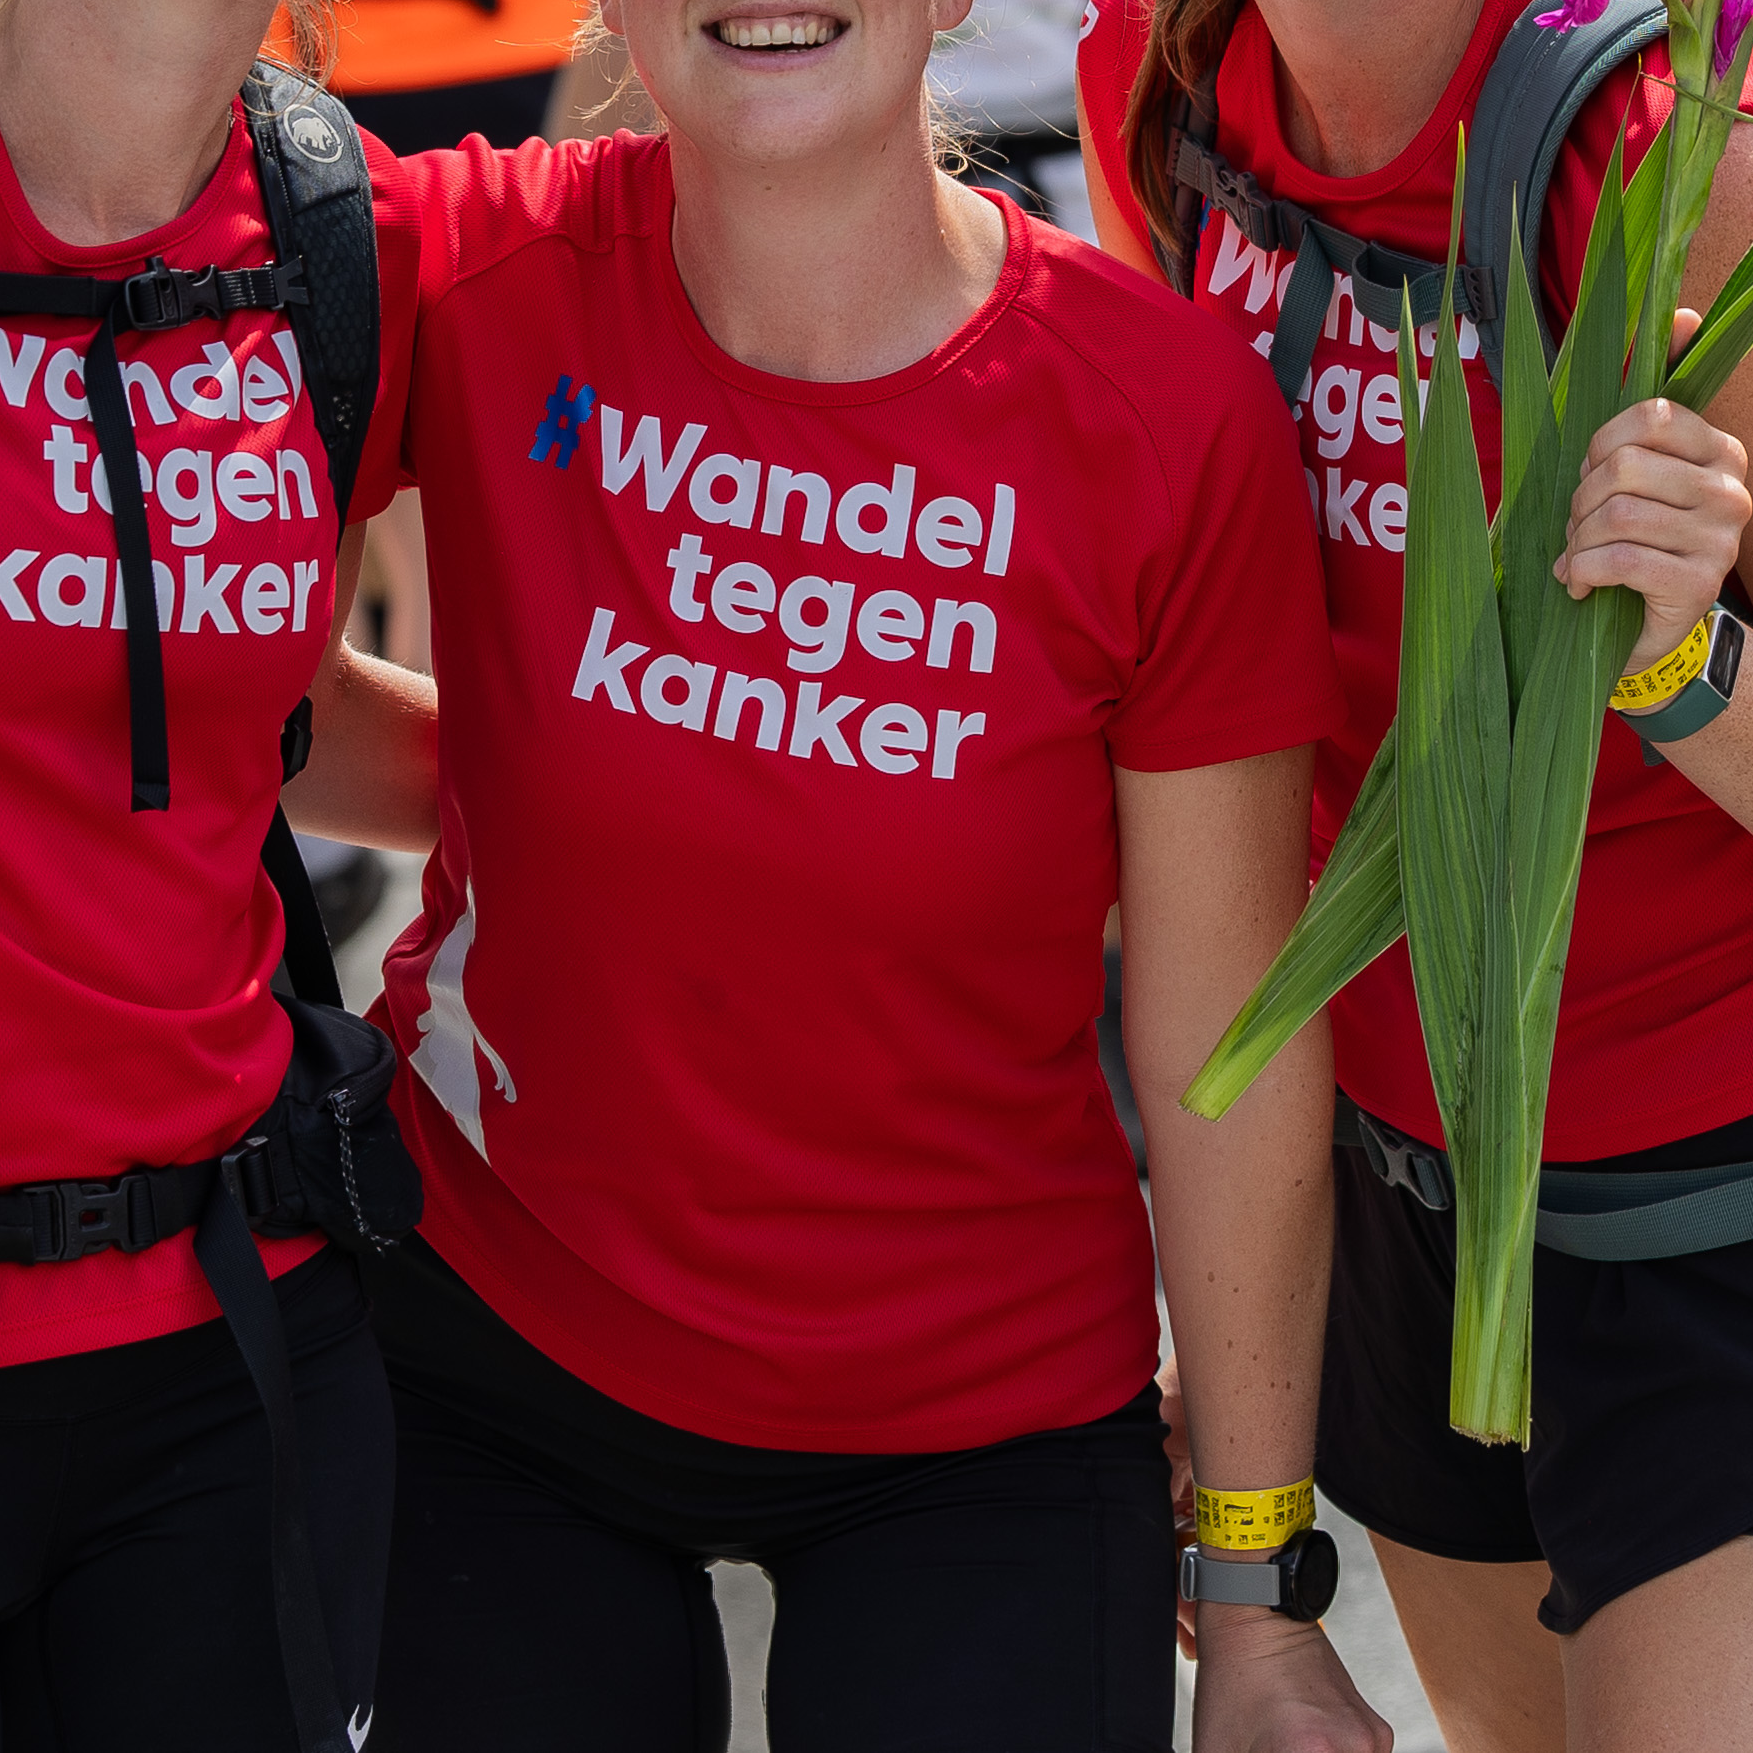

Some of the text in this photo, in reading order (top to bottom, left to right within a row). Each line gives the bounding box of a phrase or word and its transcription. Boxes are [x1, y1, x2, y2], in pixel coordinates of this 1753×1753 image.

[528, 374, 1016, 577] #Wandel
[666, 533, 998, 675] tegen
[571, 607, 987, 780] kanker
